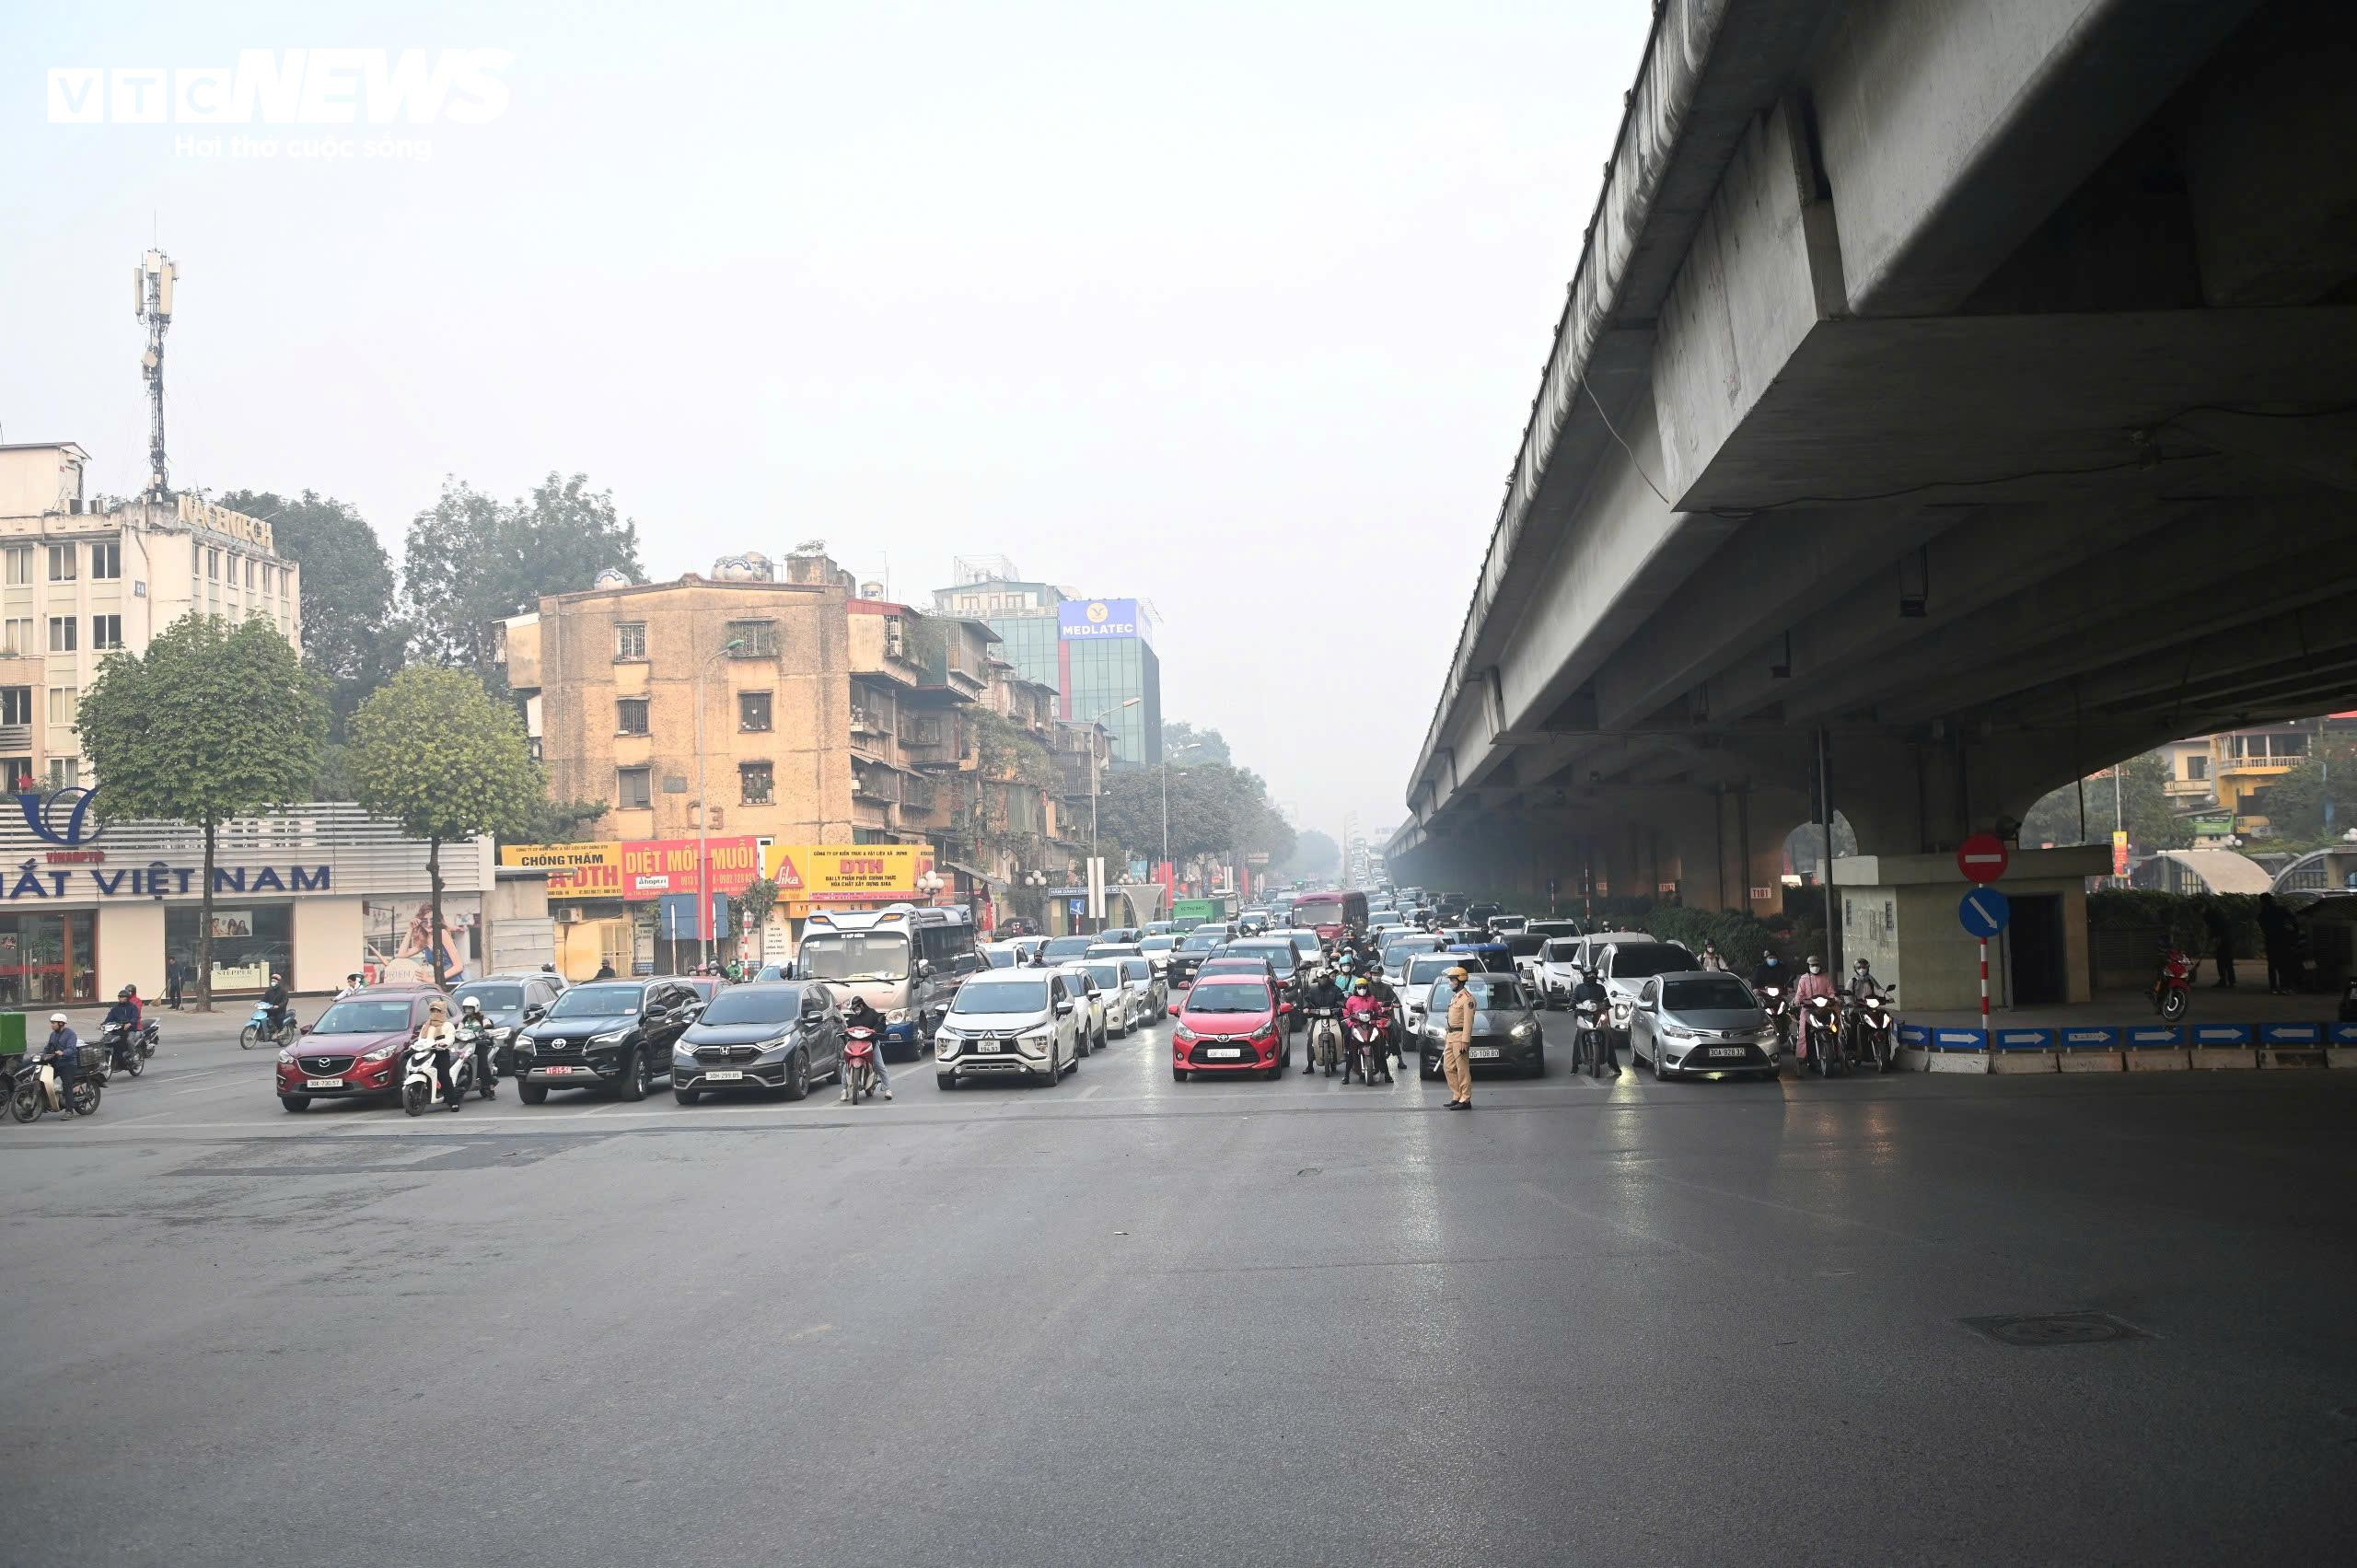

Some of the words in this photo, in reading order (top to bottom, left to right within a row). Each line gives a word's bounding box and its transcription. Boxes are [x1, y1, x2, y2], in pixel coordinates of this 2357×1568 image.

[178, 494, 273, 549] NACENTECH
[1062, 623, 1134, 635] MEDLATEC
[626, 847, 661, 877] DIỆT
[840, 859, 884, 874] DTH
[0, 857, 71, 899] ẮT
[213, 865, 331, 892] NAM
[774, 866, 799, 885] Sika
